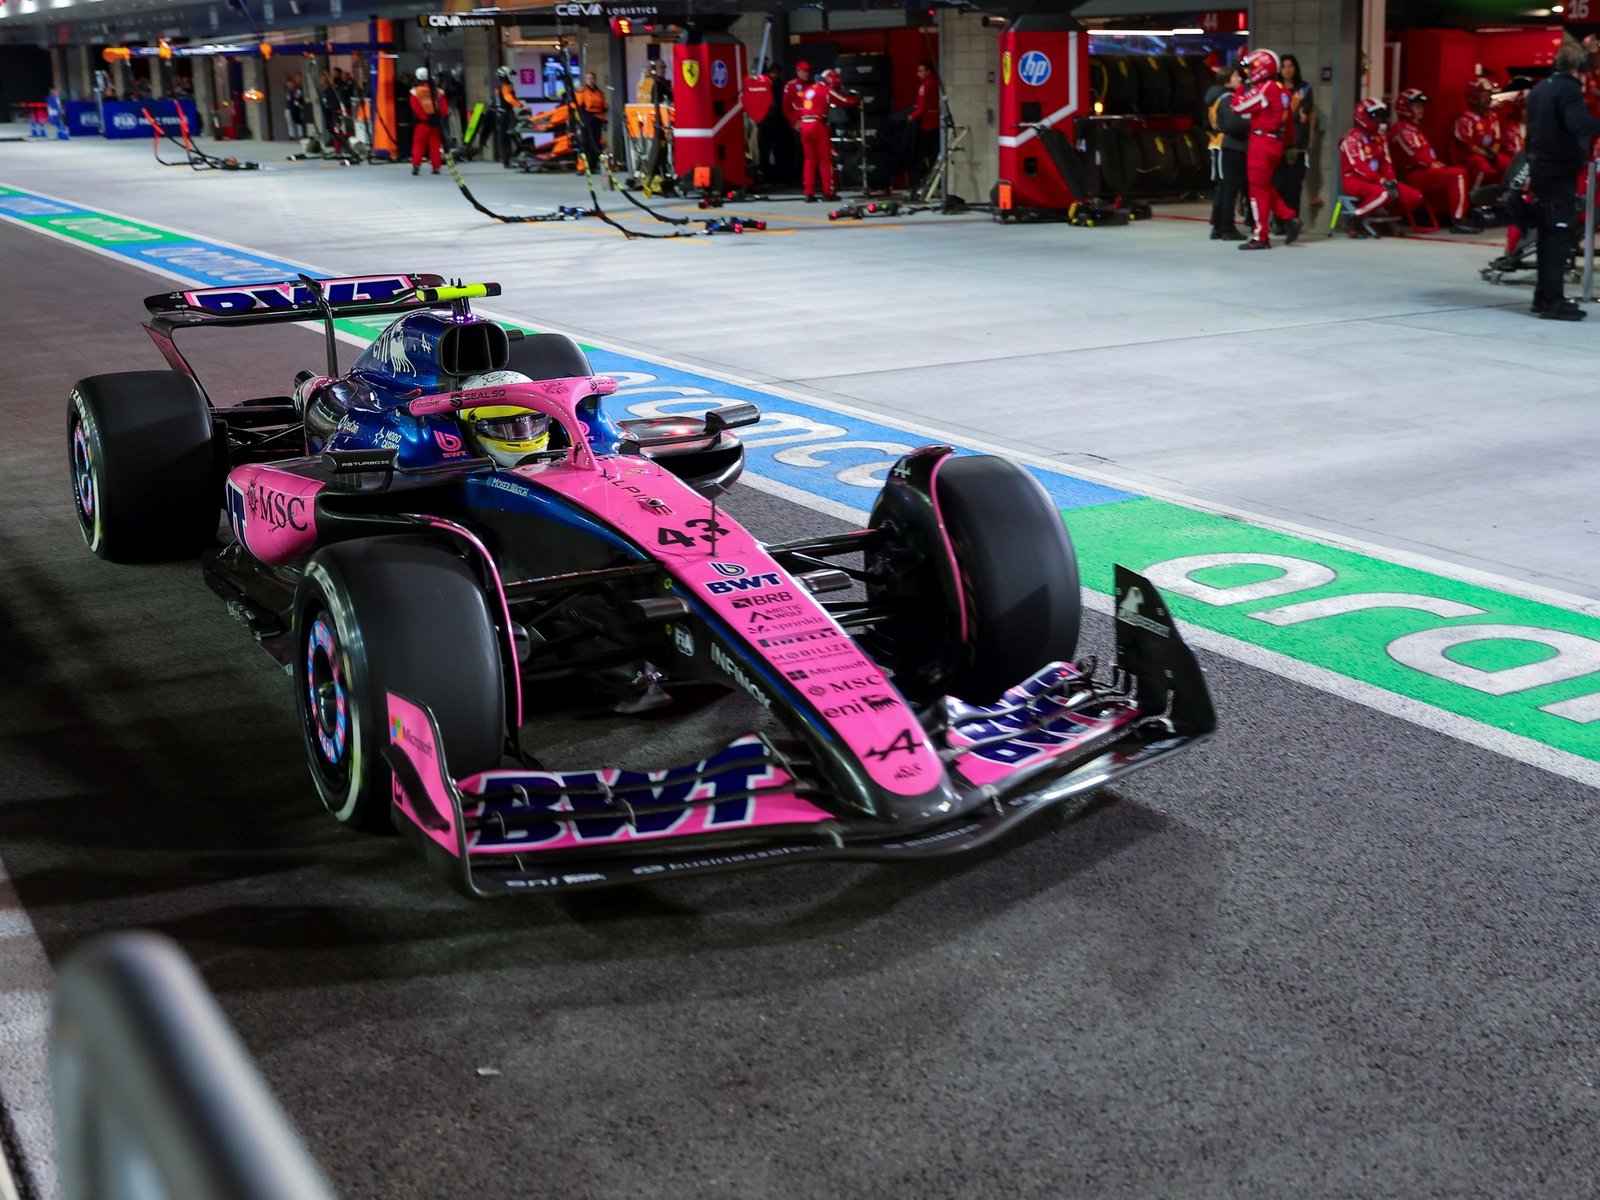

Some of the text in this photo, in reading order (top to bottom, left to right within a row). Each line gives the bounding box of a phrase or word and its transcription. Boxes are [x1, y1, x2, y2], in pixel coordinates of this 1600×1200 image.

[606, 6, 657, 15] LOGISTICS
[1021, 53, 1049, 84] hp
[464, 389, 506, 401] SEAL SQ
[259, 486, 308, 532] MSC
[657, 518, 730, 548] 43
[704, 572, 781, 595] BWT
[752, 591, 793, 606] BRB
[765, 604, 805, 614] ARCTIC
[773, 610, 804, 619] WOLF
[772, 616, 824, 632] sprinklr
[772, 643, 852, 661] MOBILIZE
[711, 642, 772, 710] INFINOX
[808, 660, 868, 676] Microsoft
[829, 675, 882, 693] MSC
[824, 698, 865, 719] eni
[470, 735, 776, 849] BWT
